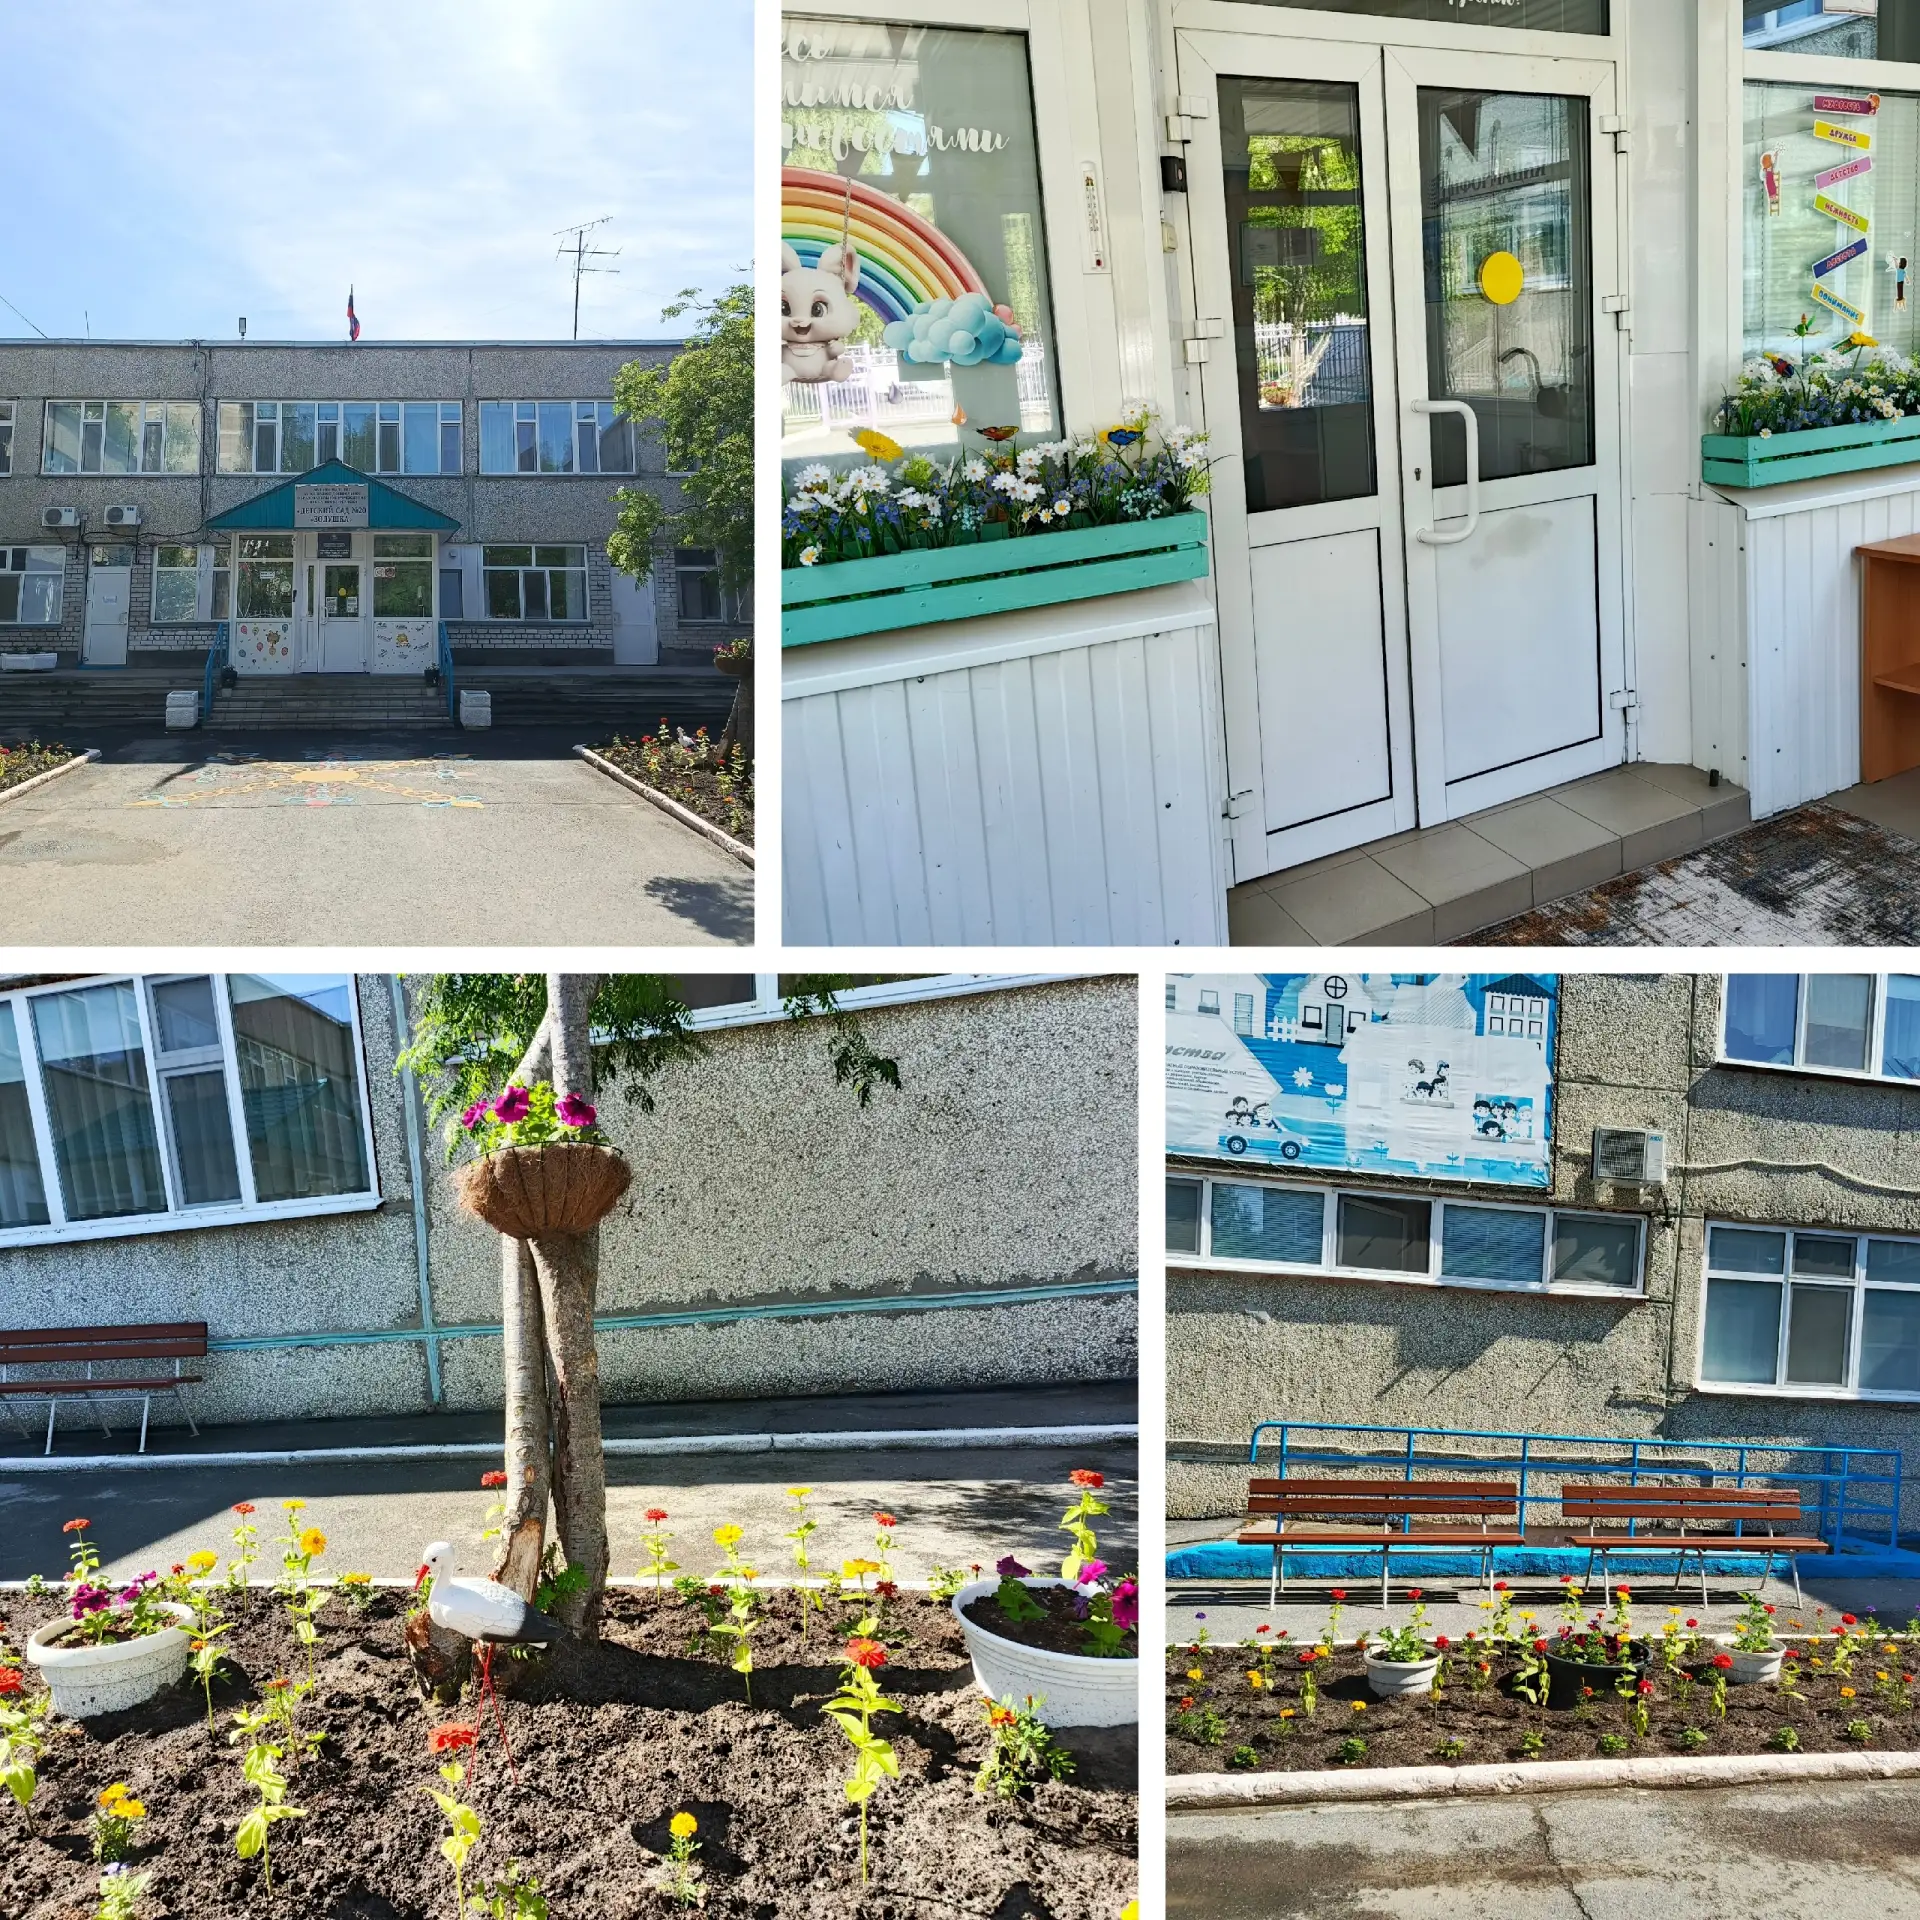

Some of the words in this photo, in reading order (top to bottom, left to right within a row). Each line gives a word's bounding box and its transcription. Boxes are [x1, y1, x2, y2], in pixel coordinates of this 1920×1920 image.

[782, 34, 830, 62] сь
[1822, 98, 1860, 112] МУДРОСТЬ
[1829, 129, 1857, 142] ДРУЖБА
[1830, 164, 1859, 181] ДЕТСТВО
[1825, 202, 1860, 226] НЕЖНОСТЬ
[1826, 247, 1857, 270] ДОБРОТА
[1818, 289, 1860, 321] ПОНИМАНИЕ
[335, 507, 350, 515] САД
